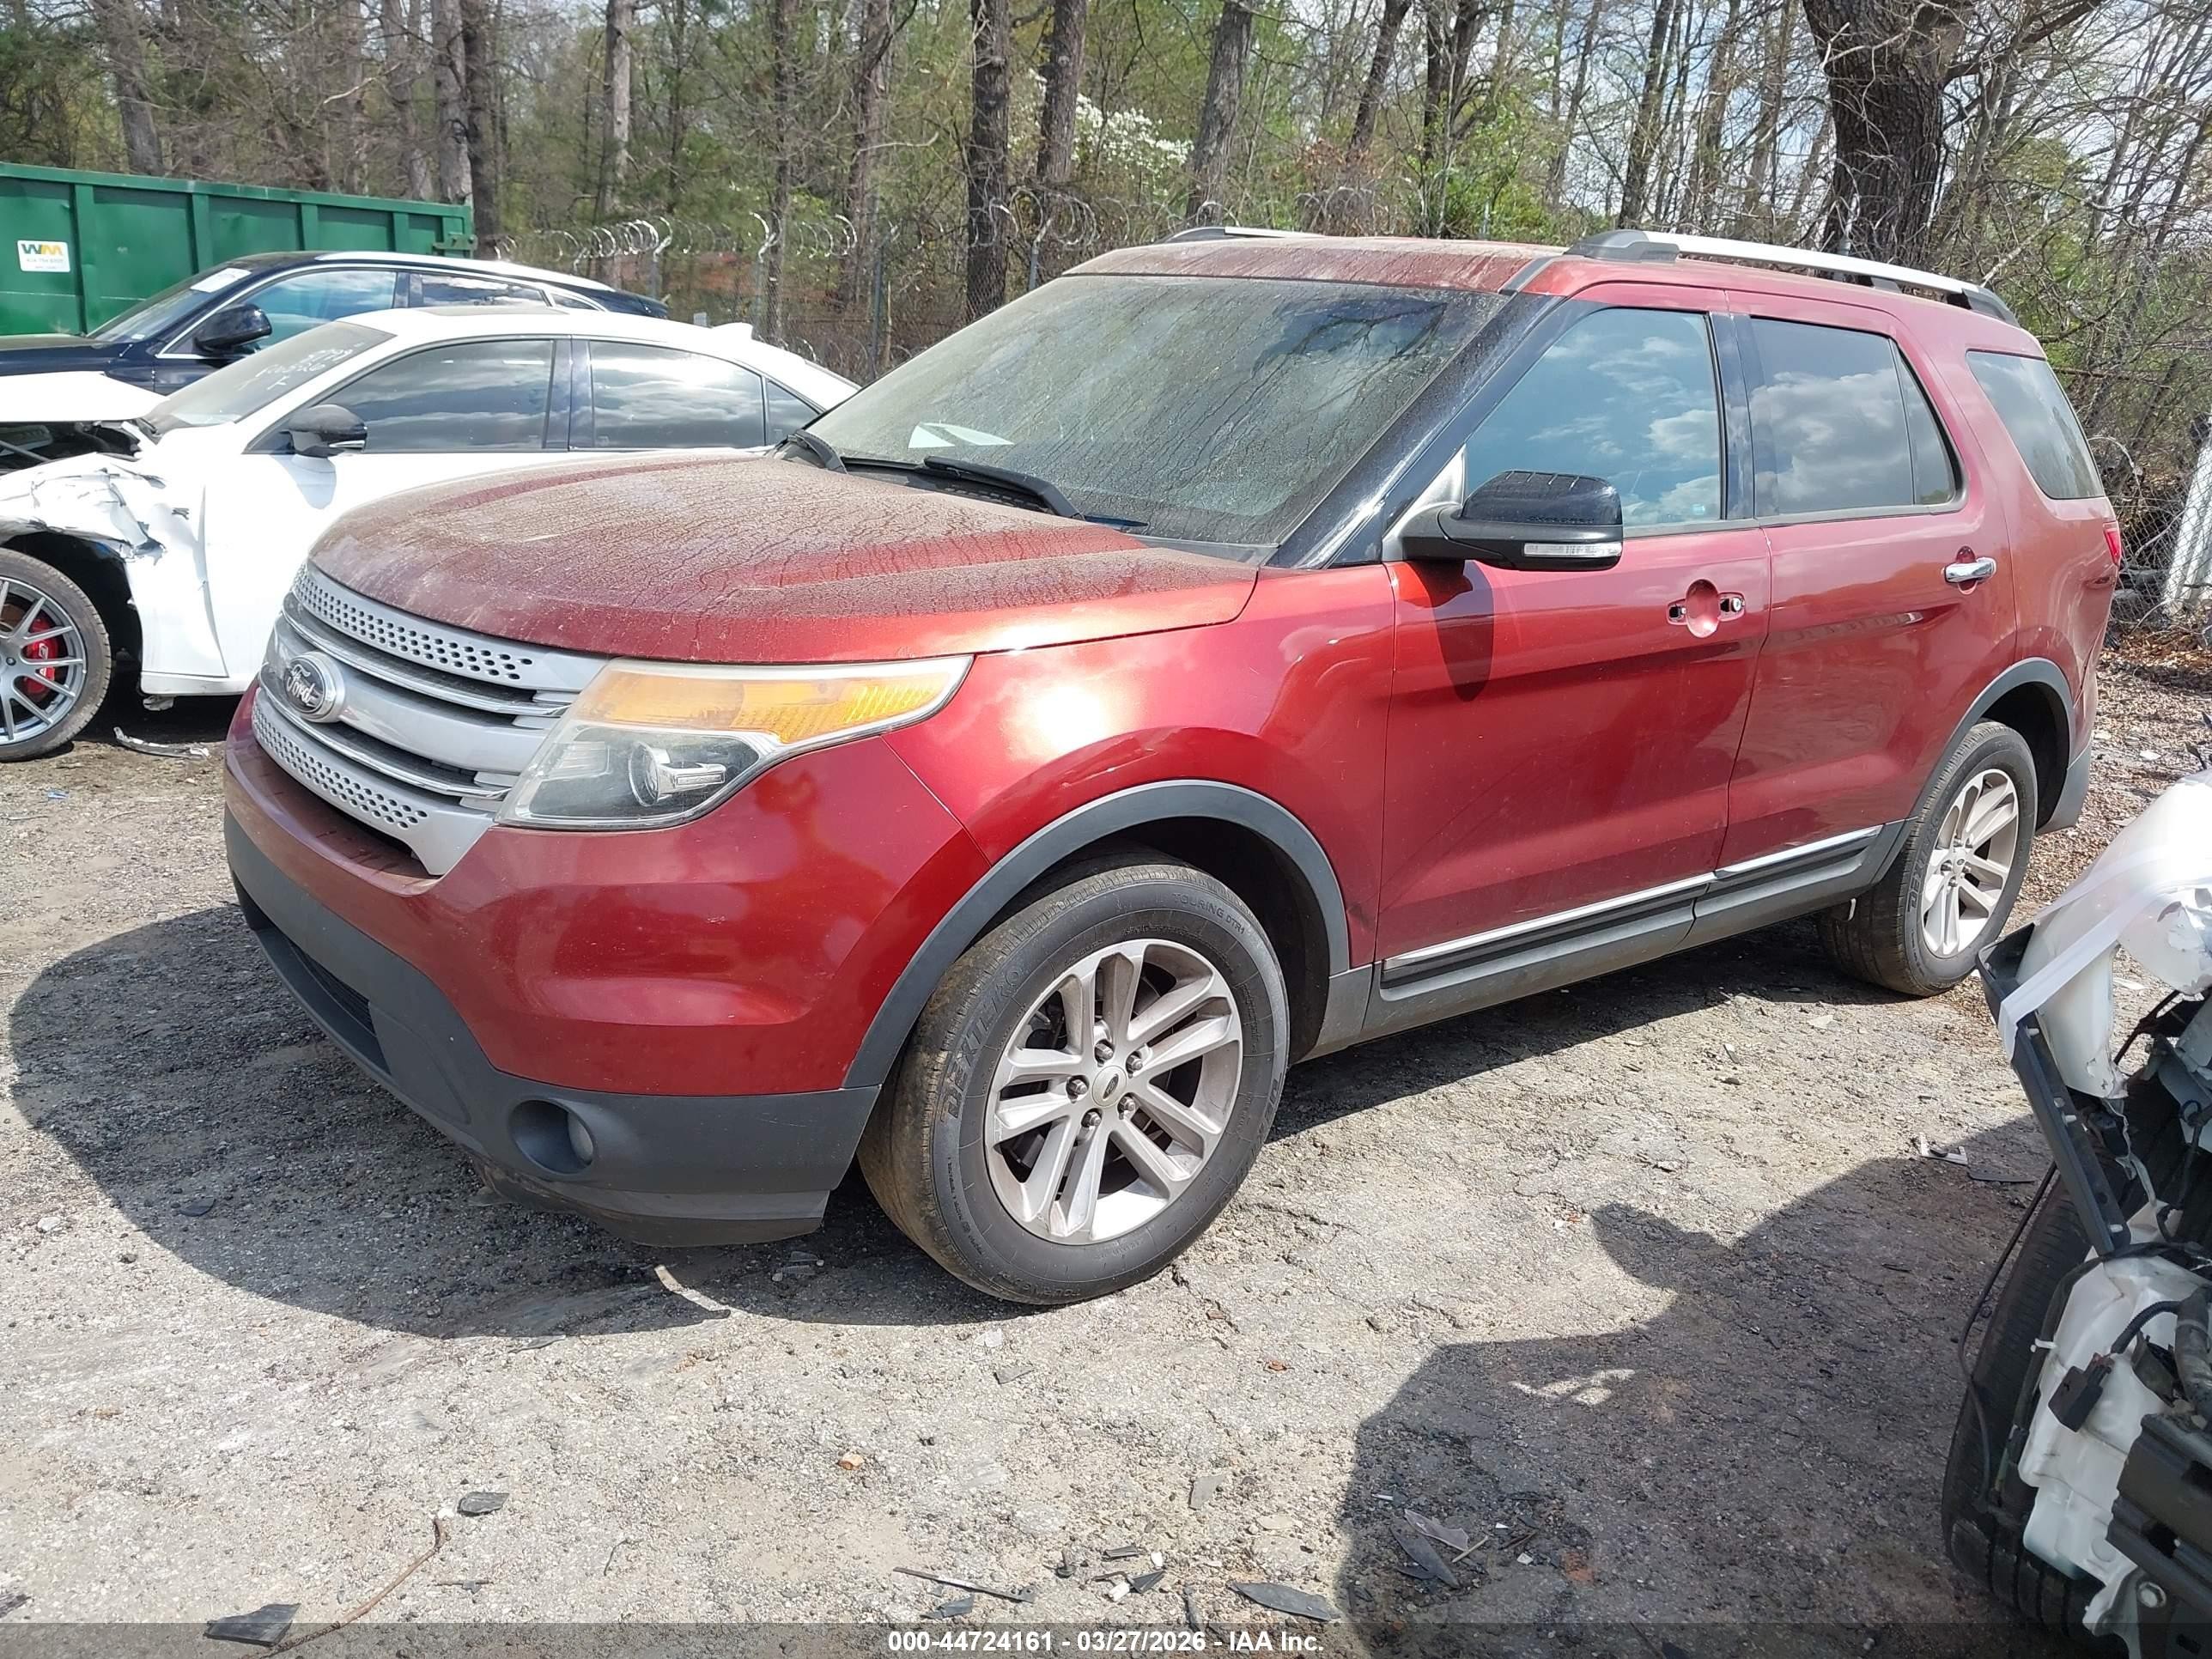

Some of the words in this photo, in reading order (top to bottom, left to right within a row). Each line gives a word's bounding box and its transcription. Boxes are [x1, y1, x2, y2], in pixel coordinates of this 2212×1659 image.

[21, 244, 63, 255] WM
[287, 664, 316, 704] Ford
[1172, 893, 1224, 919] TOURING
